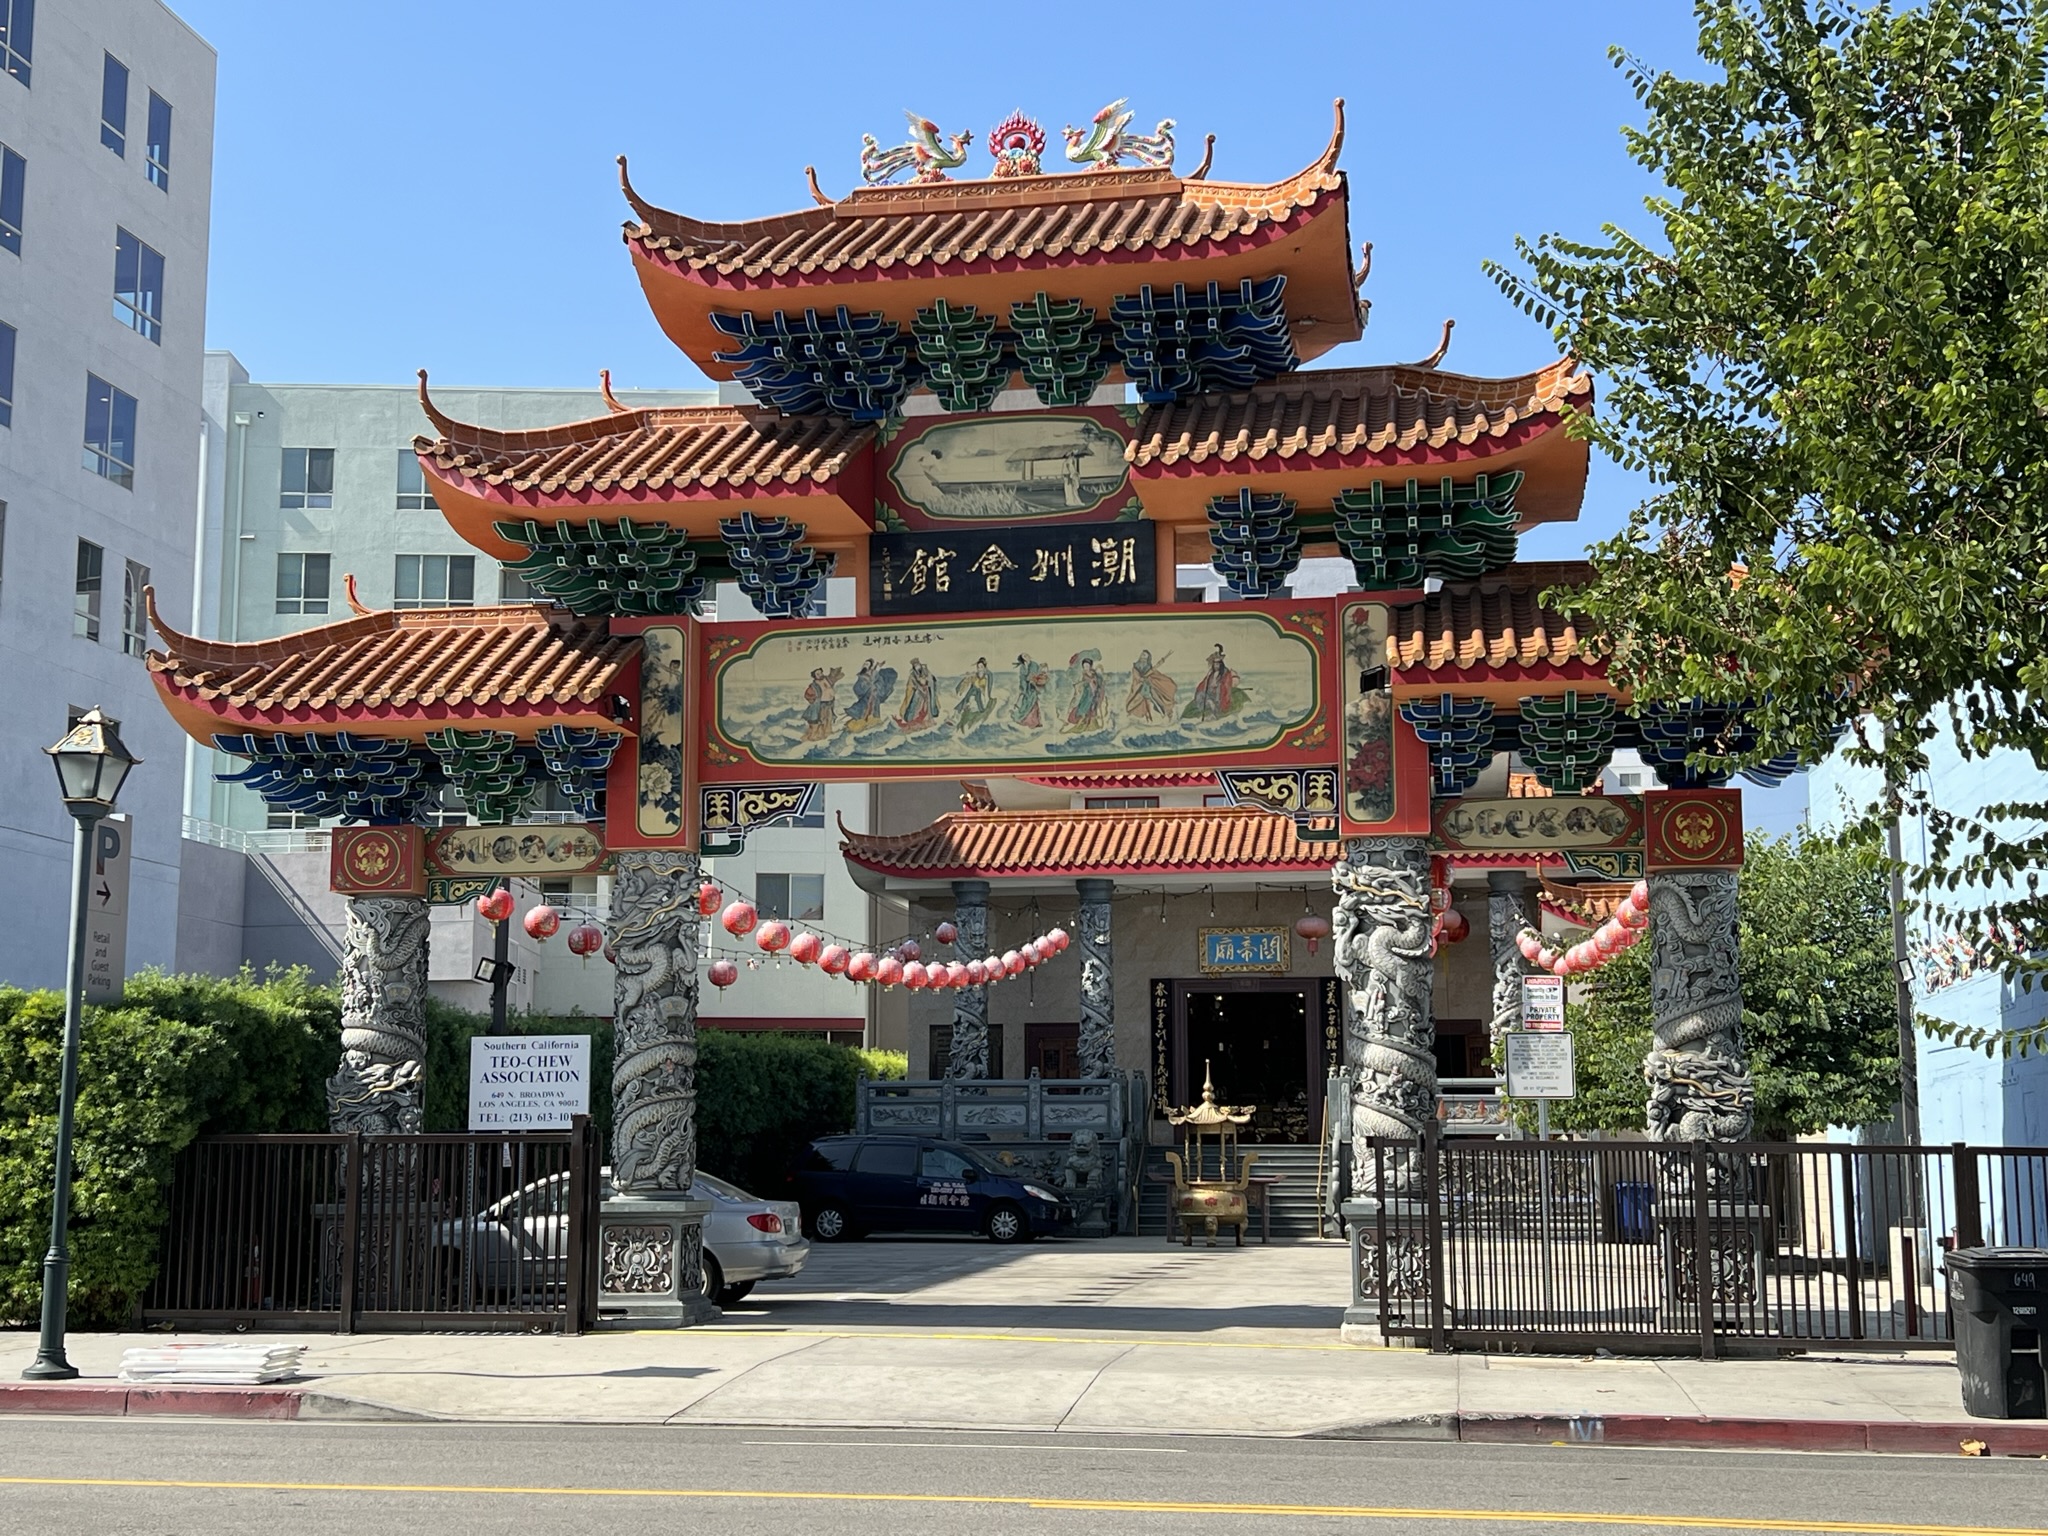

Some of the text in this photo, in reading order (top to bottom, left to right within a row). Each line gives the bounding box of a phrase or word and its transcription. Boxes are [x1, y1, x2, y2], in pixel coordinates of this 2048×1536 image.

[96, 825, 120, 875] P
[93, 930, 110, 944] Retail
[95, 947, 107, 958] and
[91, 959, 109, 972] Guest
[88, 973, 111, 990] Parking
[483, 1040, 579, 1051] Southern California
[490, 1055, 573, 1069] TEO-CHEW
[480, 1070, 580, 1084] ASSOCIATION
[508, 1091, 515, 1099] N.
[519, 1091, 566, 1099] BROADWAY
[500, 1100, 540, 1109] ANGELES,
[543, 1100, 555, 1108] CA
[558, 1099, 579, 1107] 90012
[478, 1112, 577, 1124] TEL: (213) 613-101
[2013, 1271, 2036, 1290] 649
